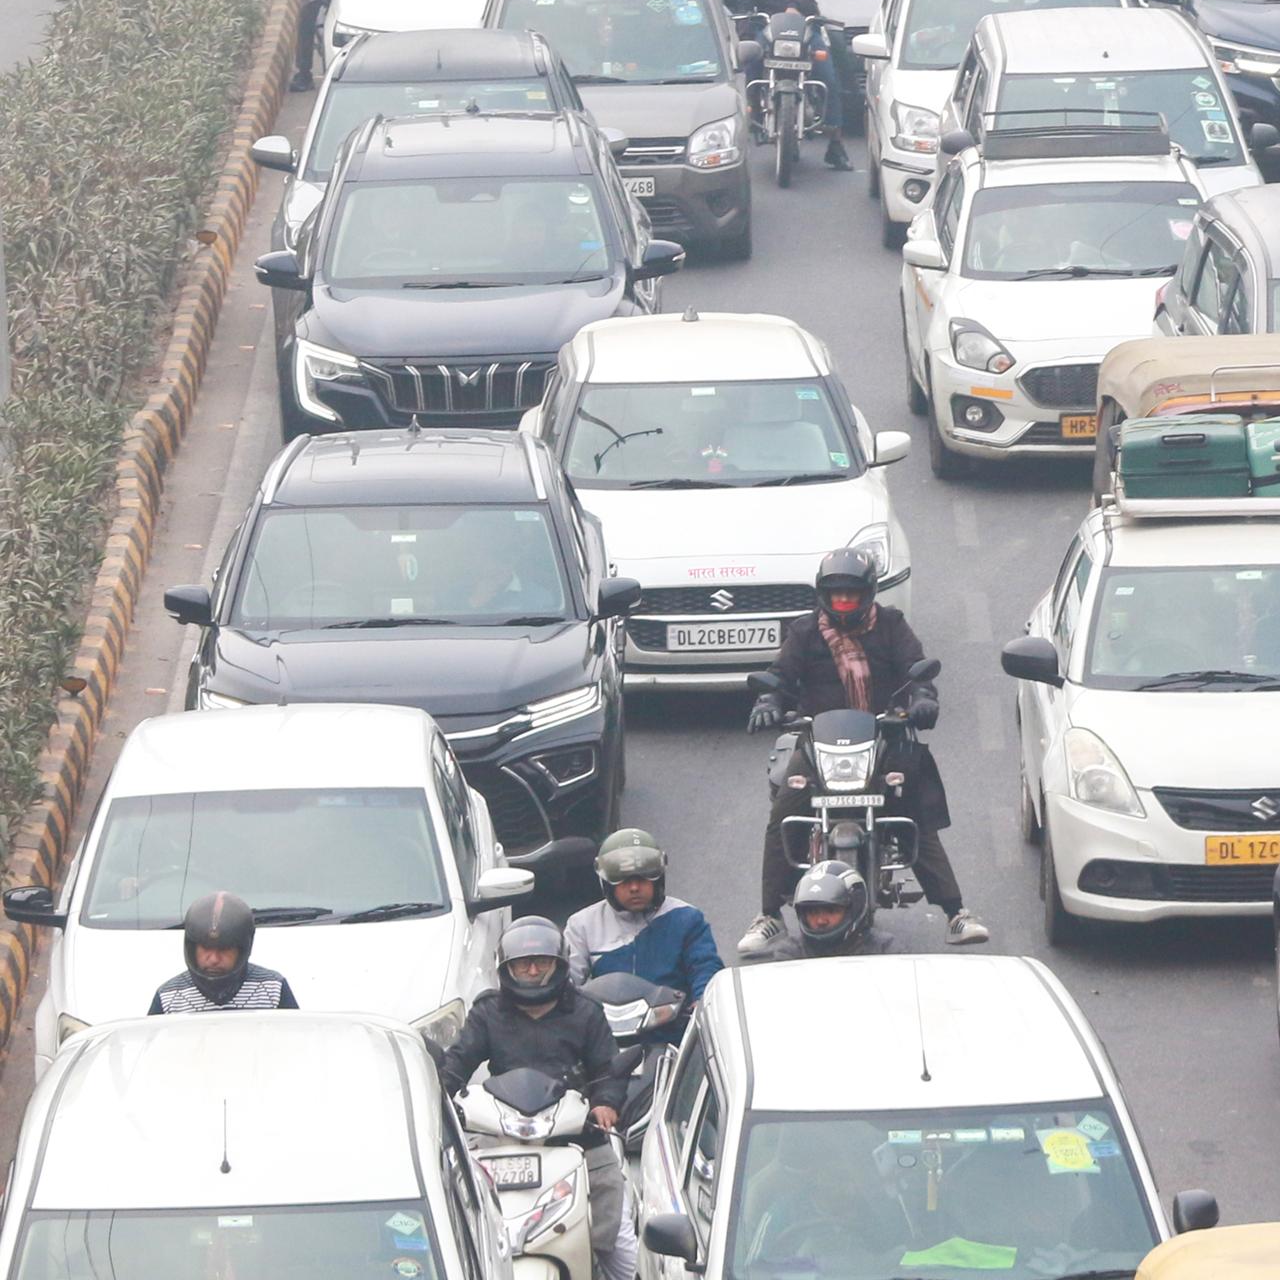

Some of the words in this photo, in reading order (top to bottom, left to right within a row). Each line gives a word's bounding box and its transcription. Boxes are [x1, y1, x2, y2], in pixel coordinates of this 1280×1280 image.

[688, 568, 715, 578] भारत
[720, 566, 756, 577] सरकार
[677, 627, 776, 646] DL2CBE0776
[1219, 842, 1241, 859] DL
